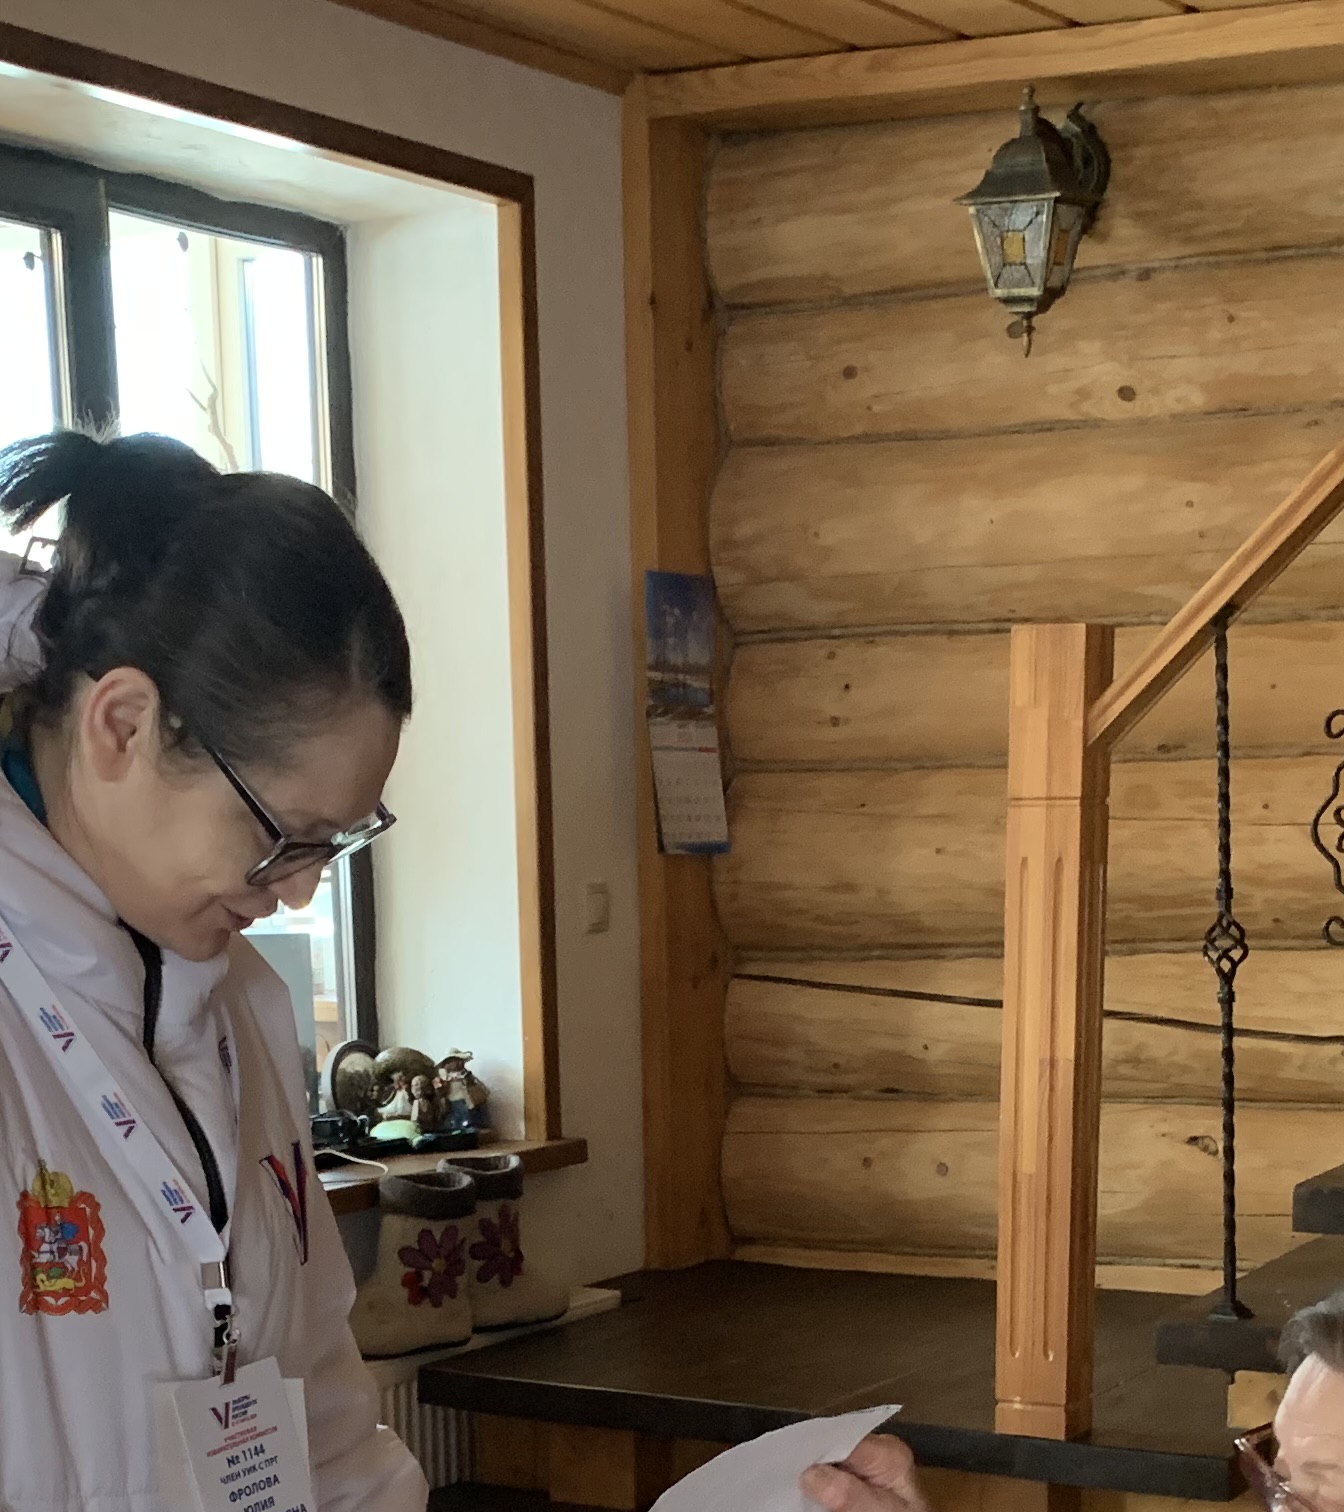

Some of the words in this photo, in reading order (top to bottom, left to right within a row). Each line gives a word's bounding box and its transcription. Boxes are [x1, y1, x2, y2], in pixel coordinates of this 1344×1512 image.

[226, 1453, 240, 1468] №
[242, 1443, 265, 1462] 1144
[220, 1471, 241, 1485] ЧЛЕН
[242, 1465, 258, 1478] УИК
[258, 1461, 265, 1471] С
[265, 1455, 279, 1468] ПРГ
[229, 1474, 280, 1502] ФРОЛОВА
